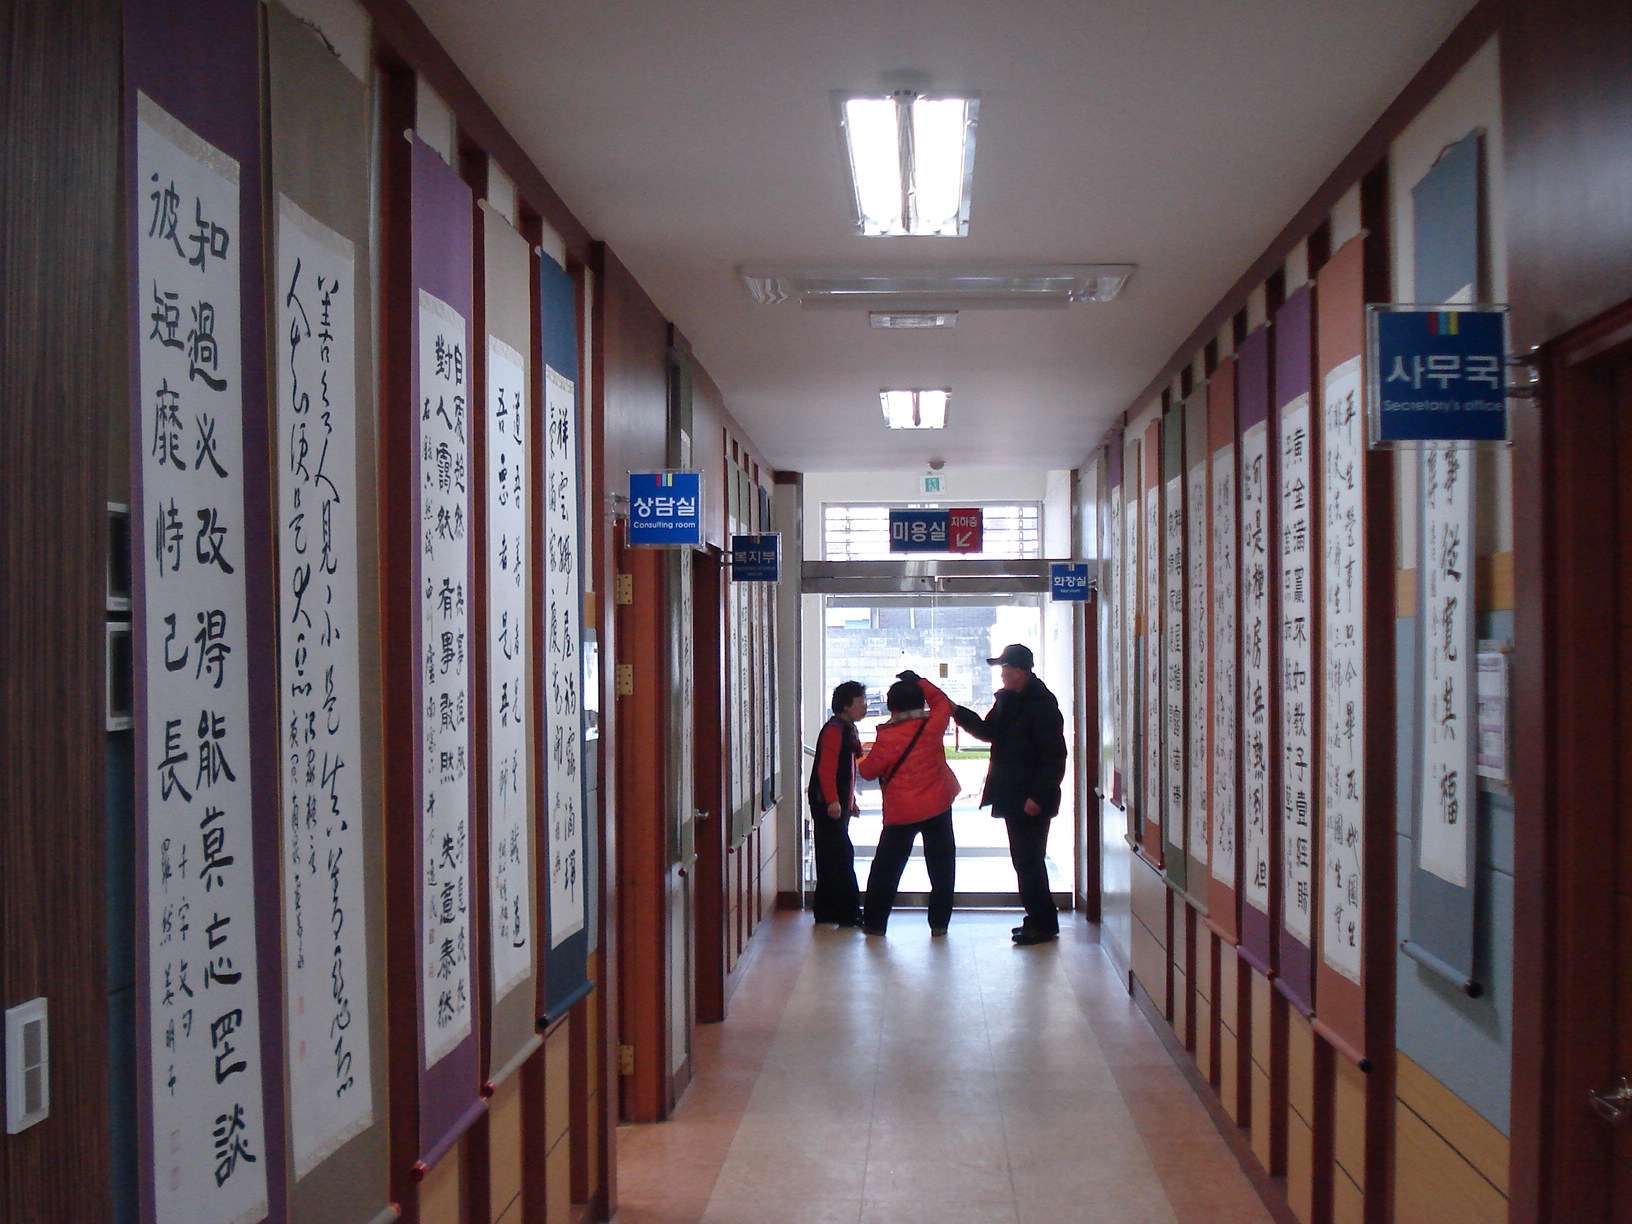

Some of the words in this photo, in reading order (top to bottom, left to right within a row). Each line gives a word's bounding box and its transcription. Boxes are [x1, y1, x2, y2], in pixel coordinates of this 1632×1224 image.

[1386, 355, 1499, 390] 사무국
[1384, 400, 1460, 411] Secretary's
[1463, 400, 1504, 411] office
[634, 497, 695, 517] 상담실
[633, 521, 673, 529] Consulting
[893, 521, 946, 542] 미용실
[735, 551, 775, 564] 복지부
[1054, 576, 1087, 587] 화장실
